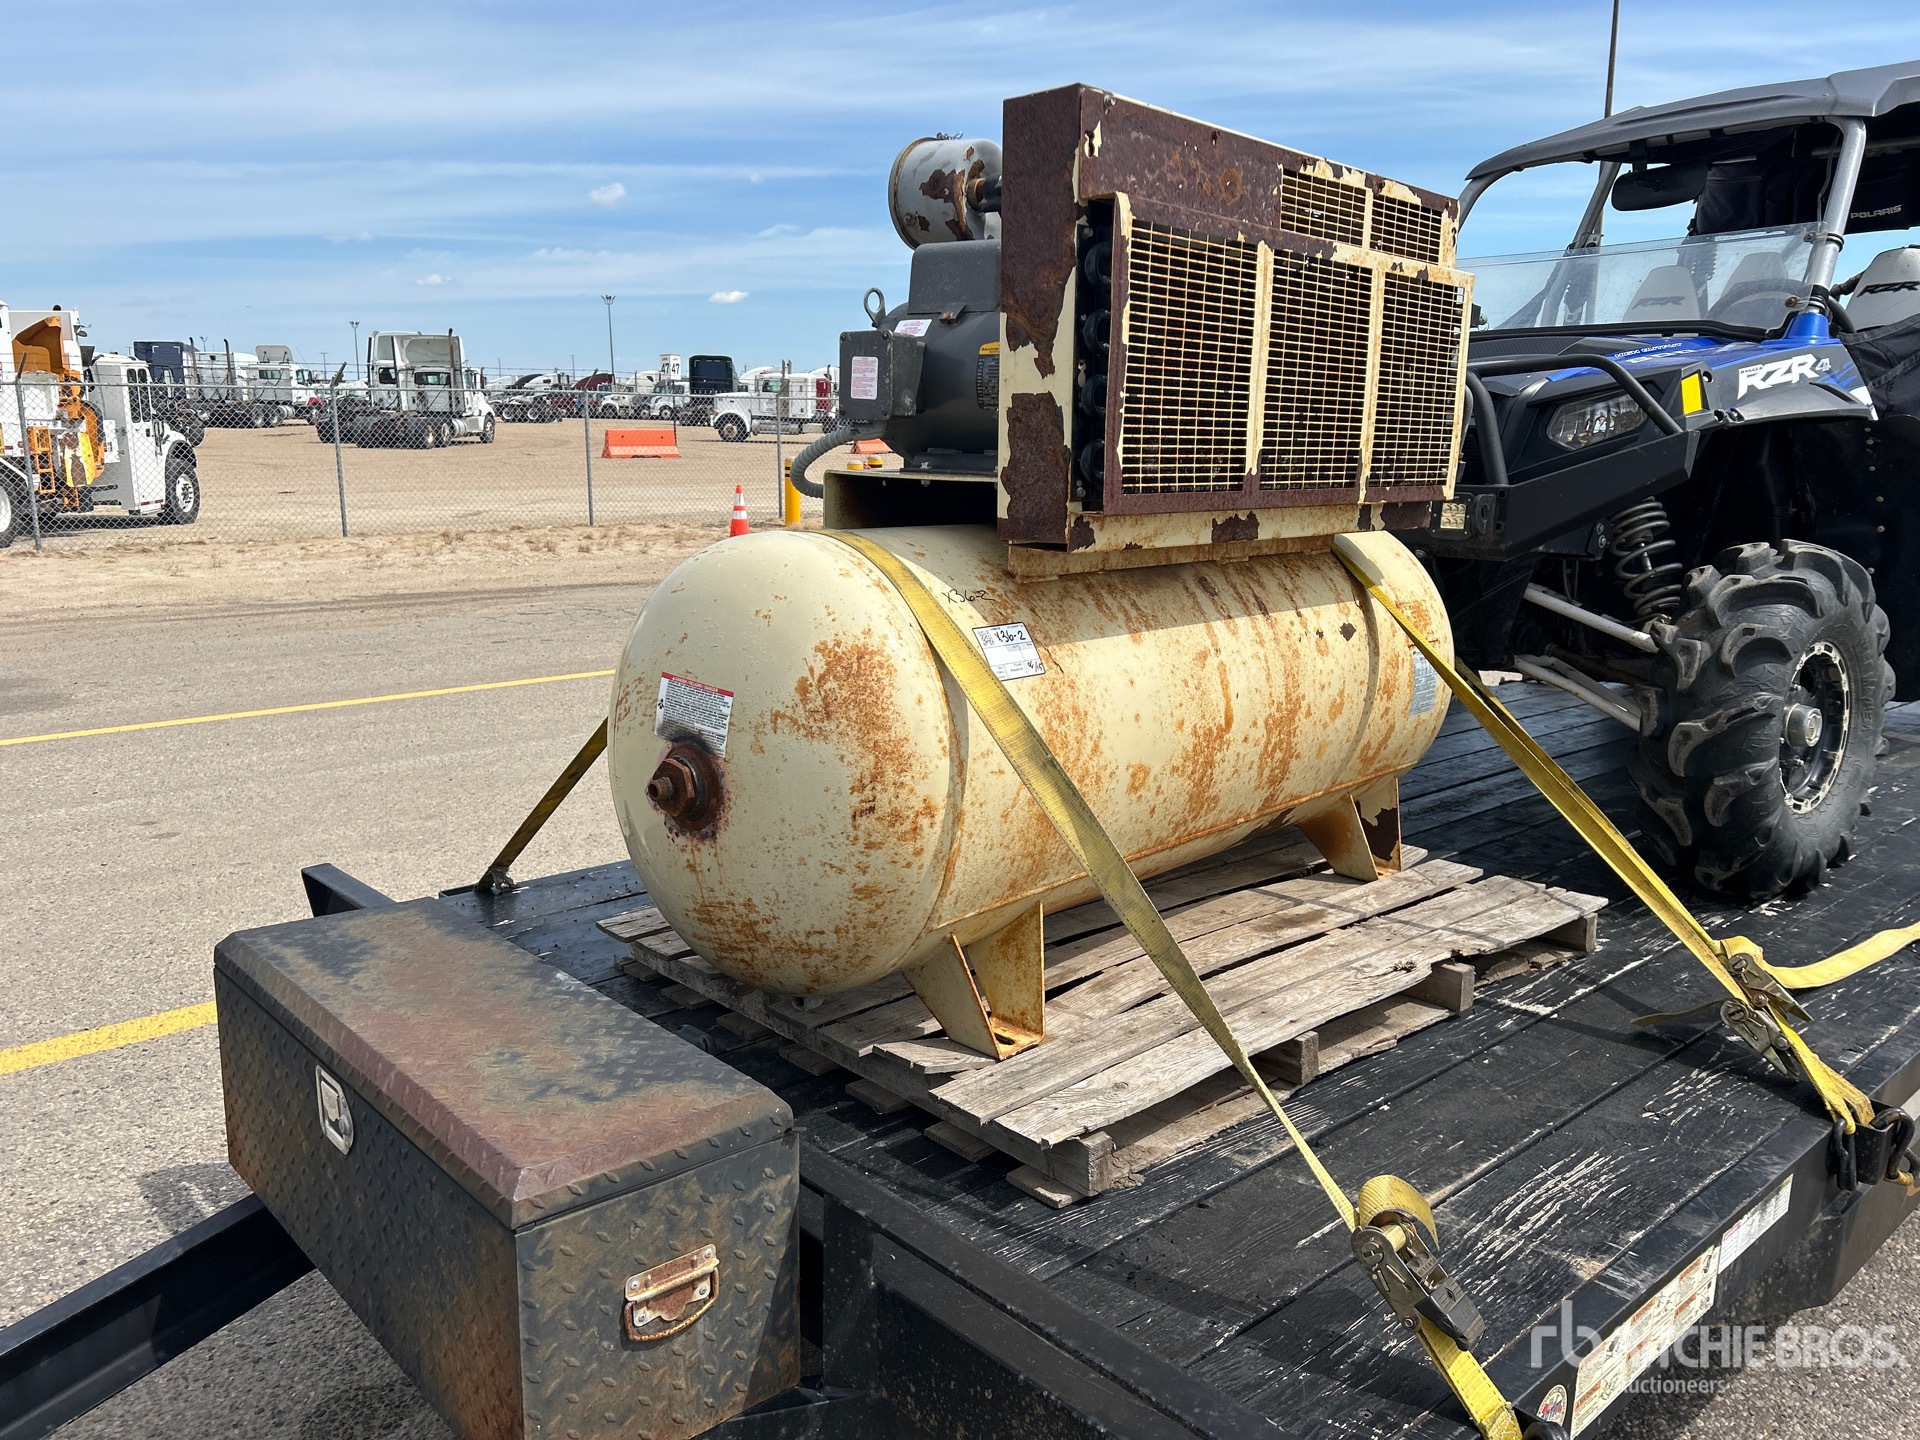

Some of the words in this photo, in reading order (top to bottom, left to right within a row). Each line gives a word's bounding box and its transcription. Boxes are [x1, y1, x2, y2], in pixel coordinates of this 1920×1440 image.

[1850, 204, 1903, 219] POLARIS
[661, 363, 670, 375] 47
[671, 363, 680, 375] 47
[1737, 353, 1820, 400] RZR
[1815, 357, 1832, 372] 4
